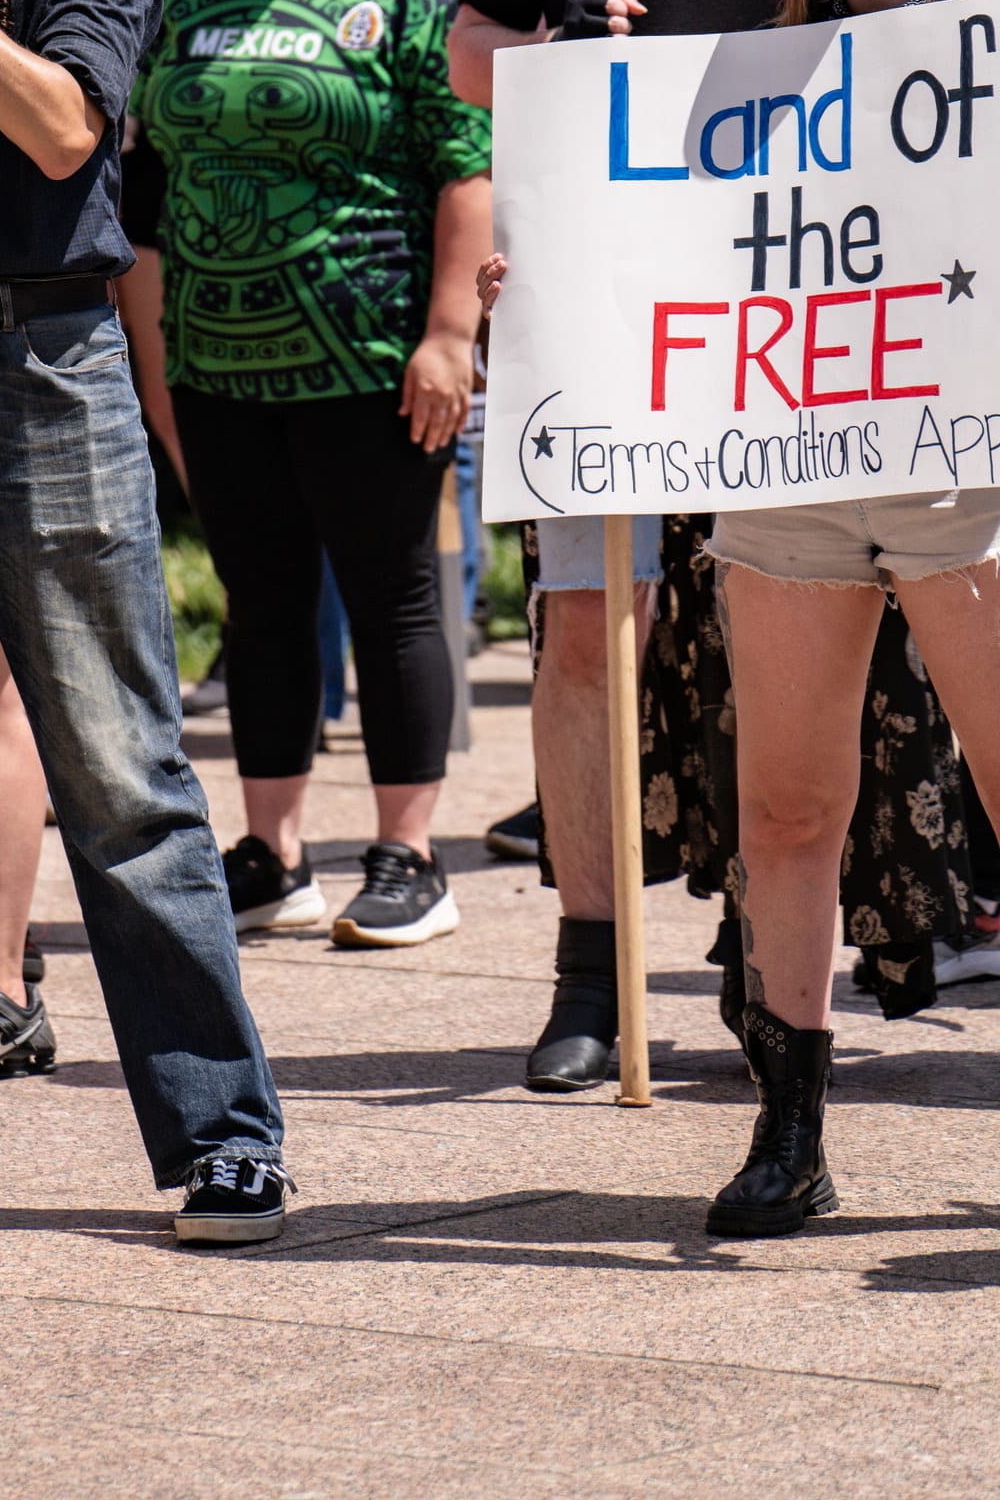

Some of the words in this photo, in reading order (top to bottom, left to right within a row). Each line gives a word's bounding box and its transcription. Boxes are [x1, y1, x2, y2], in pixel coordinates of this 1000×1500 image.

[190, 27, 323, 62] MEXICO
[609, 33, 852, 181] Land
[890, 14, 997, 163] of
[733, 186, 883, 292] the
[651, 282, 943, 412] FREE
